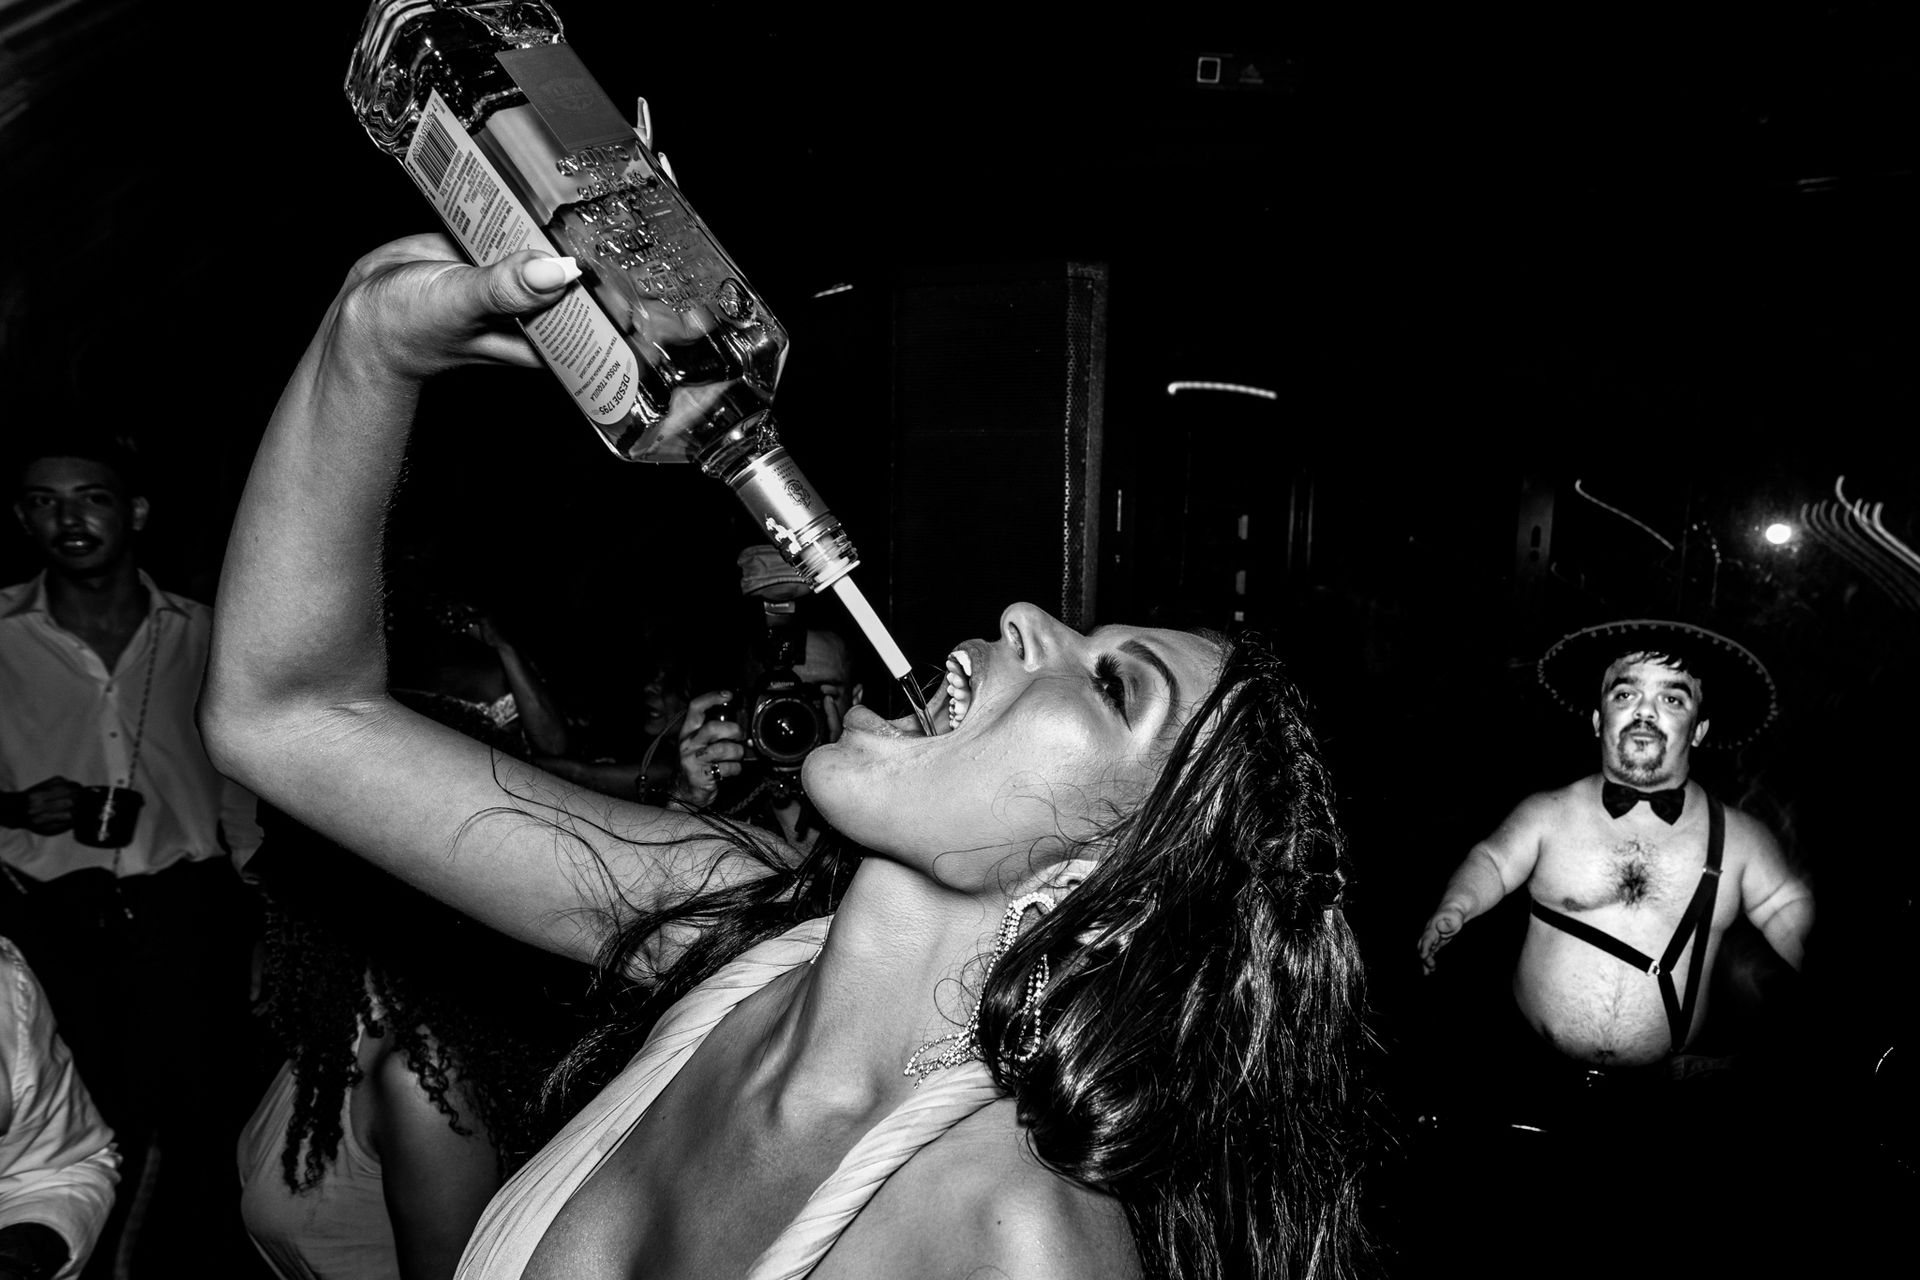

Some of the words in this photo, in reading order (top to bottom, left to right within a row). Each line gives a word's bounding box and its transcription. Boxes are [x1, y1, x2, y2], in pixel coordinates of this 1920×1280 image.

[604, 360, 620, 381] NOSSA
[589, 378, 606, 401] TEQUILA
[611, 373, 630, 405] DESDE
[598, 401, 615, 415] 1795
